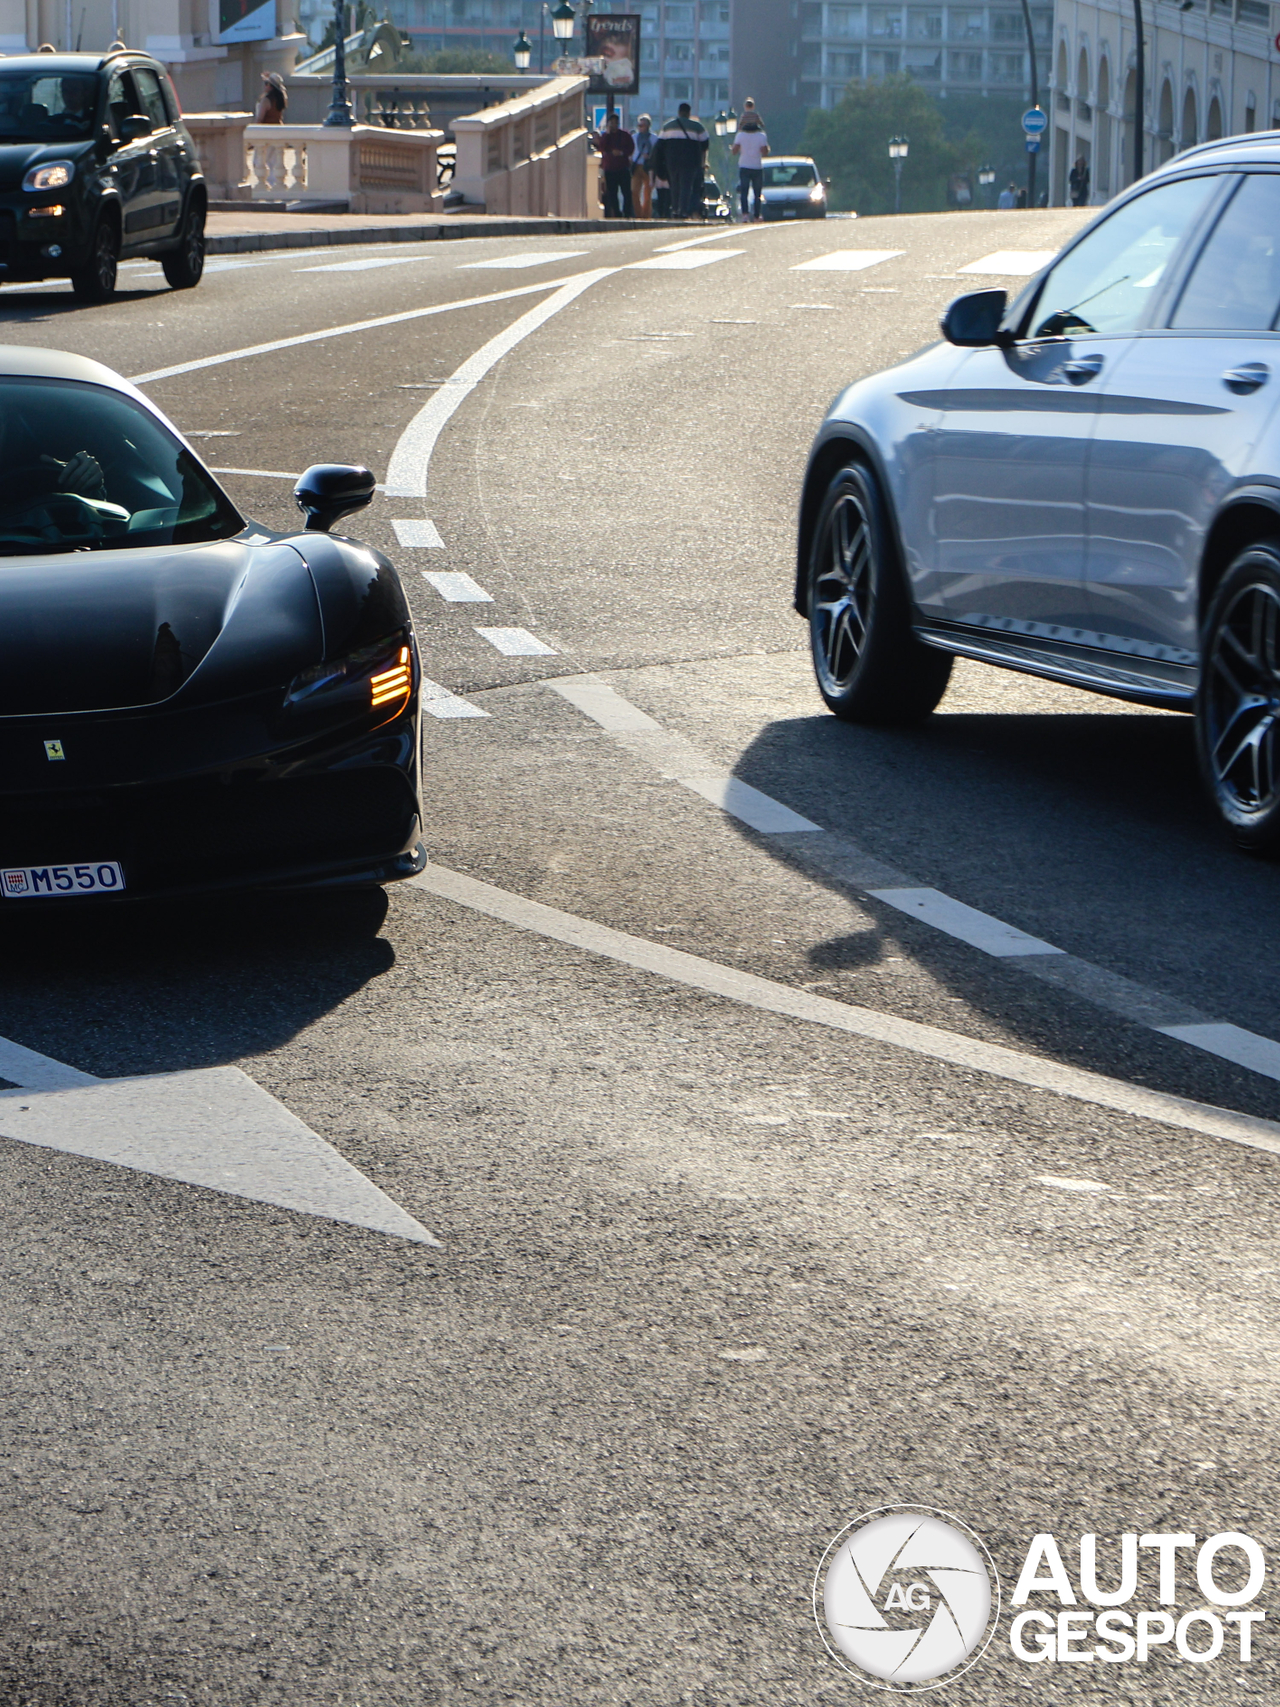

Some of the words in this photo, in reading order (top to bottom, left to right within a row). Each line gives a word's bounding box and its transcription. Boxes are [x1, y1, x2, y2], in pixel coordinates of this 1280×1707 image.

[590, 19, 633, 32] trends
[10, 883, 24, 892] MC
[30, 865, 117, 892] M550
